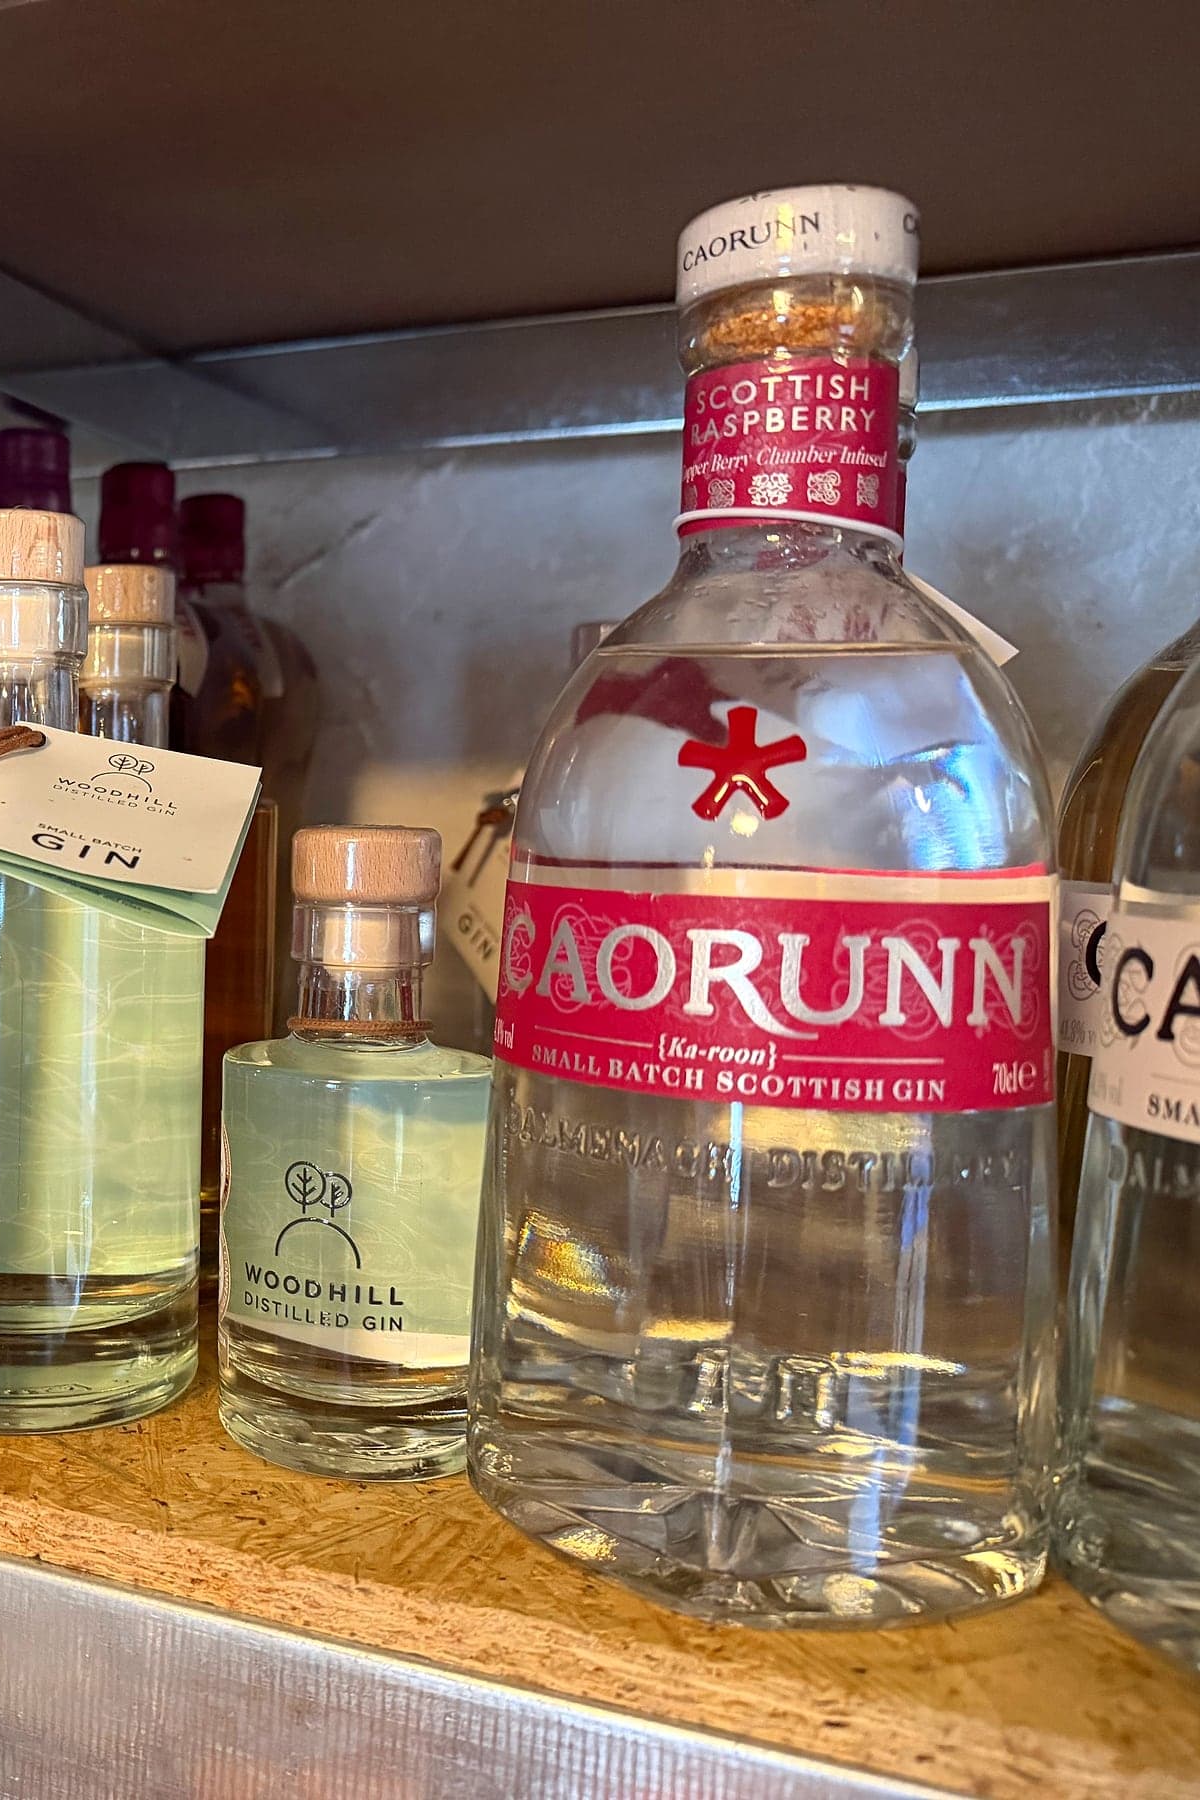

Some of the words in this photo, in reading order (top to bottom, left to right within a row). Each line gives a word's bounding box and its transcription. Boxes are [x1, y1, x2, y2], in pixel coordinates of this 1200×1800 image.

[682, 211, 820, 272] CAORUNN
[697, 374, 870, 414] SCOTTISH
[691, 406, 876, 447] RASPBERRY
[683, 461, 710, 484] pper
[711, 453, 752, 474] Berry
[757, 444, 839, 465] Chamber
[840, 446, 888, 468] Infused
[52, 784, 139, 809] DISTILLED
[146, 805, 176, 817] GIN
[58, 777, 179, 810] WOODHILL
[31, 833, 141, 870] GIN
[38, 823, 87, 841] SMALL
[92, 838, 143, 854] BATCH
[457, 913, 493, 961] GIN
[506, 914, 1027, 1040] CAORUNN
[658, 1033, 777, 1070] {Ka-roon}
[532, 1044, 601, 1076] SMALL
[608, 1058, 704, 1090] BATCH
[716, 1070, 884, 1102] SCOTTISH
[892, 1079, 947, 1102] GIN
[245, 1262, 404, 1306] WOODHILL
[245, 1291, 349, 1328] DISTILLED
[362, 1315, 403, 1331] GIN
